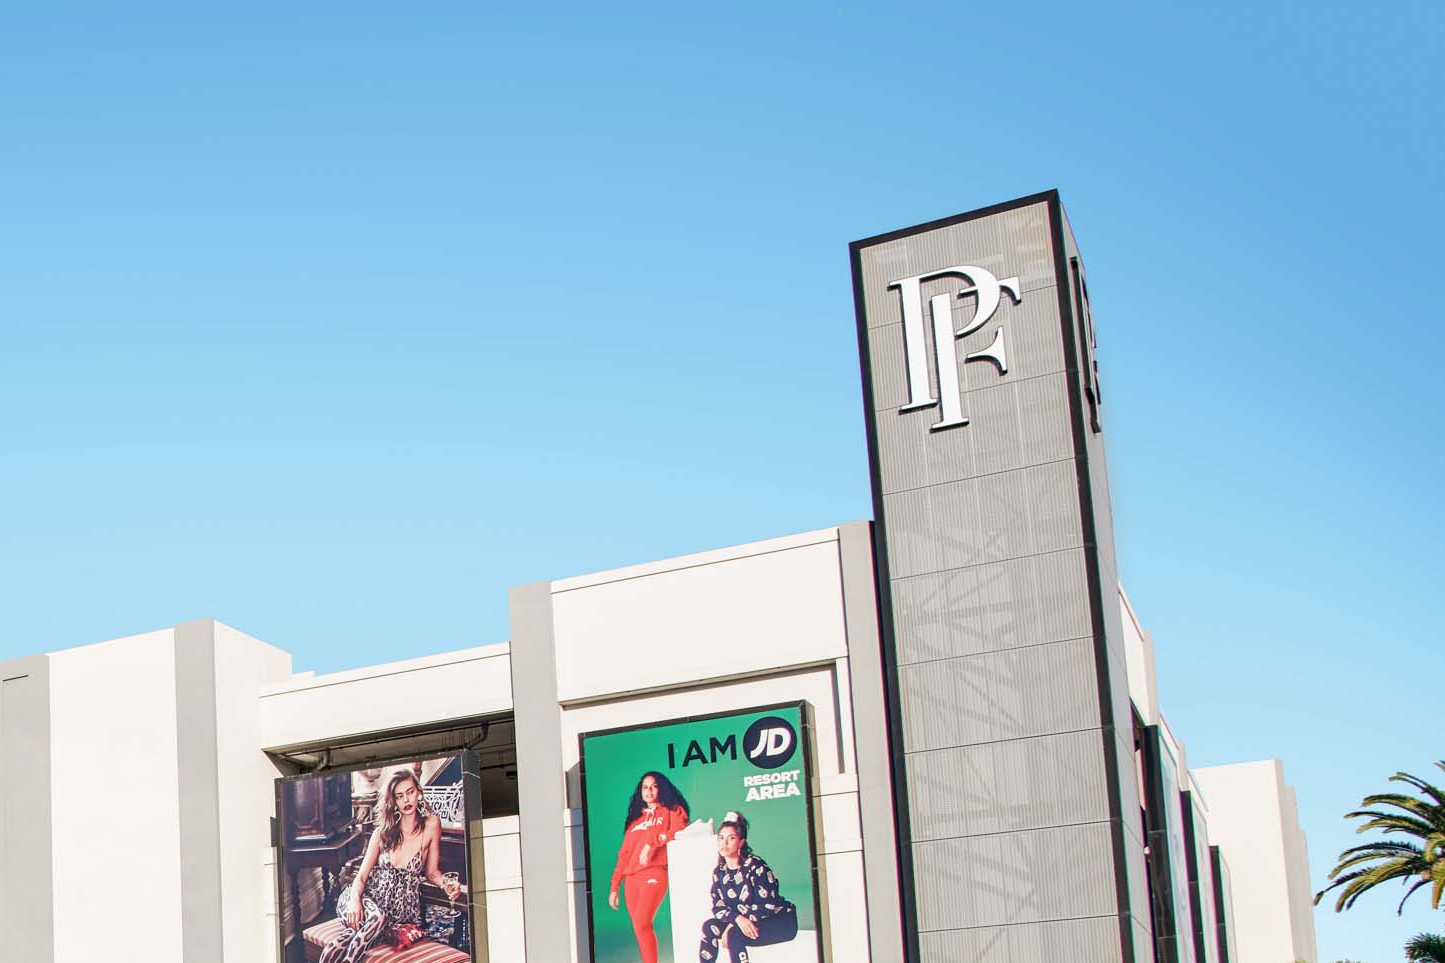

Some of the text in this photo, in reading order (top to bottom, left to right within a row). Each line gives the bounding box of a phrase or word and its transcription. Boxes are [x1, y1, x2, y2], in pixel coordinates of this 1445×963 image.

[667, 727, 792, 769] I AM JD
[743, 769, 801, 788] RESORT
[744, 782, 801, 802] AREA
